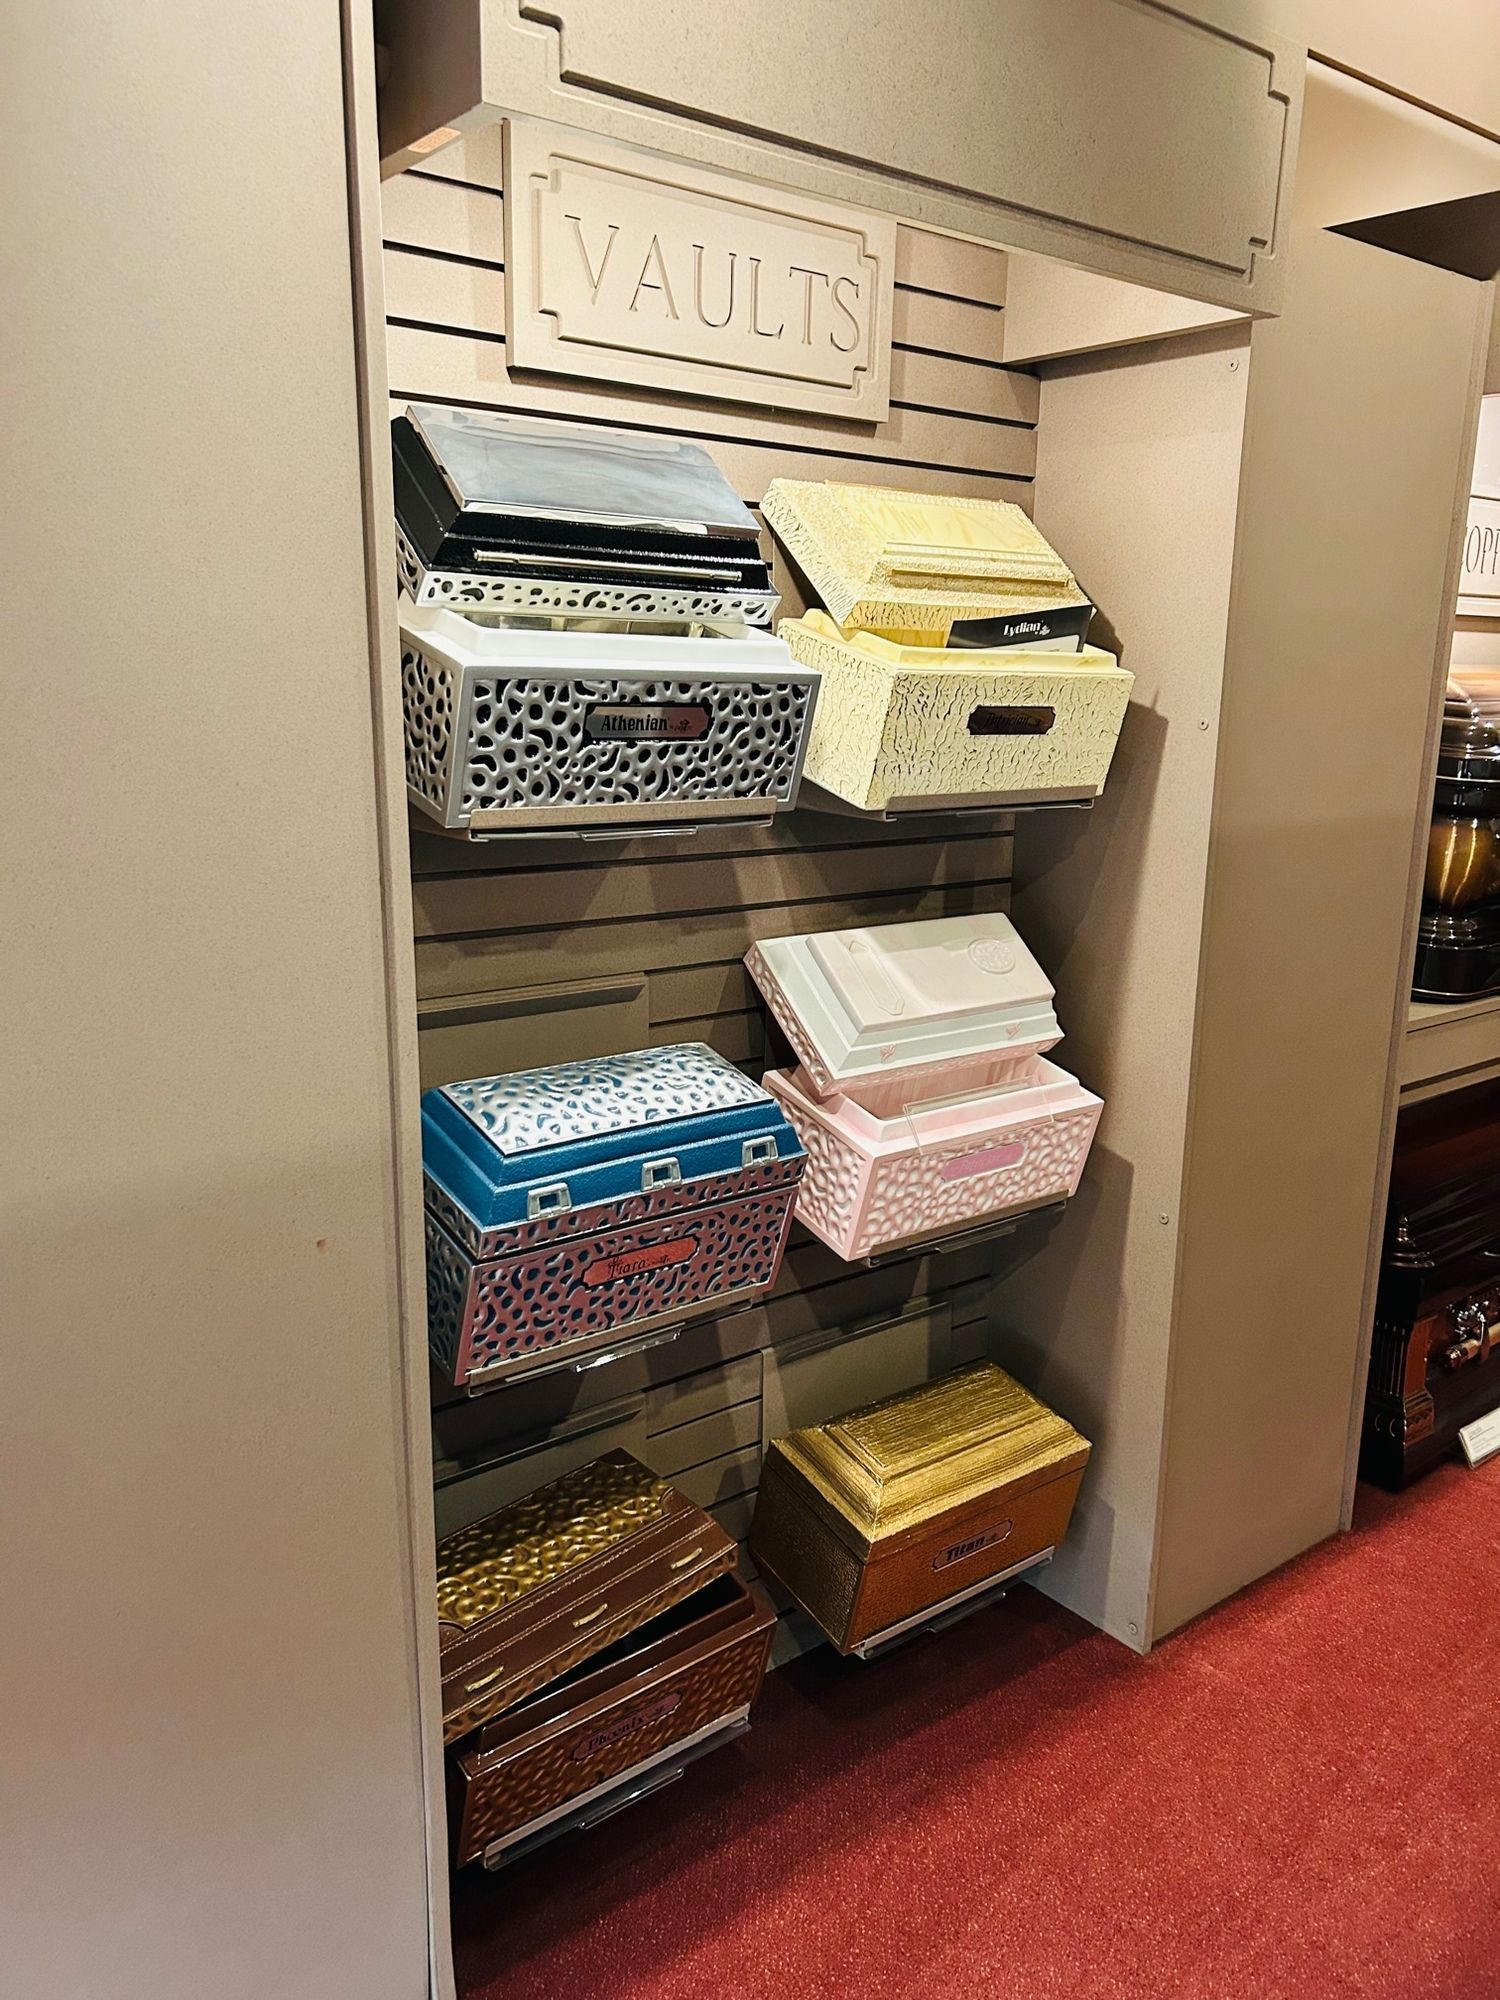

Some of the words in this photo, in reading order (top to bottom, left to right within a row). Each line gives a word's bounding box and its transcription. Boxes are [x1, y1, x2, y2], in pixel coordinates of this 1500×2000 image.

[565, 214, 859, 352] VAULTS
[1003, 621, 1041, 637] Lydian
[601, 714, 668, 731] Athenian
[608, 1256, 646, 1278] Tiara
[946, 1536, 986, 1560] Titan
